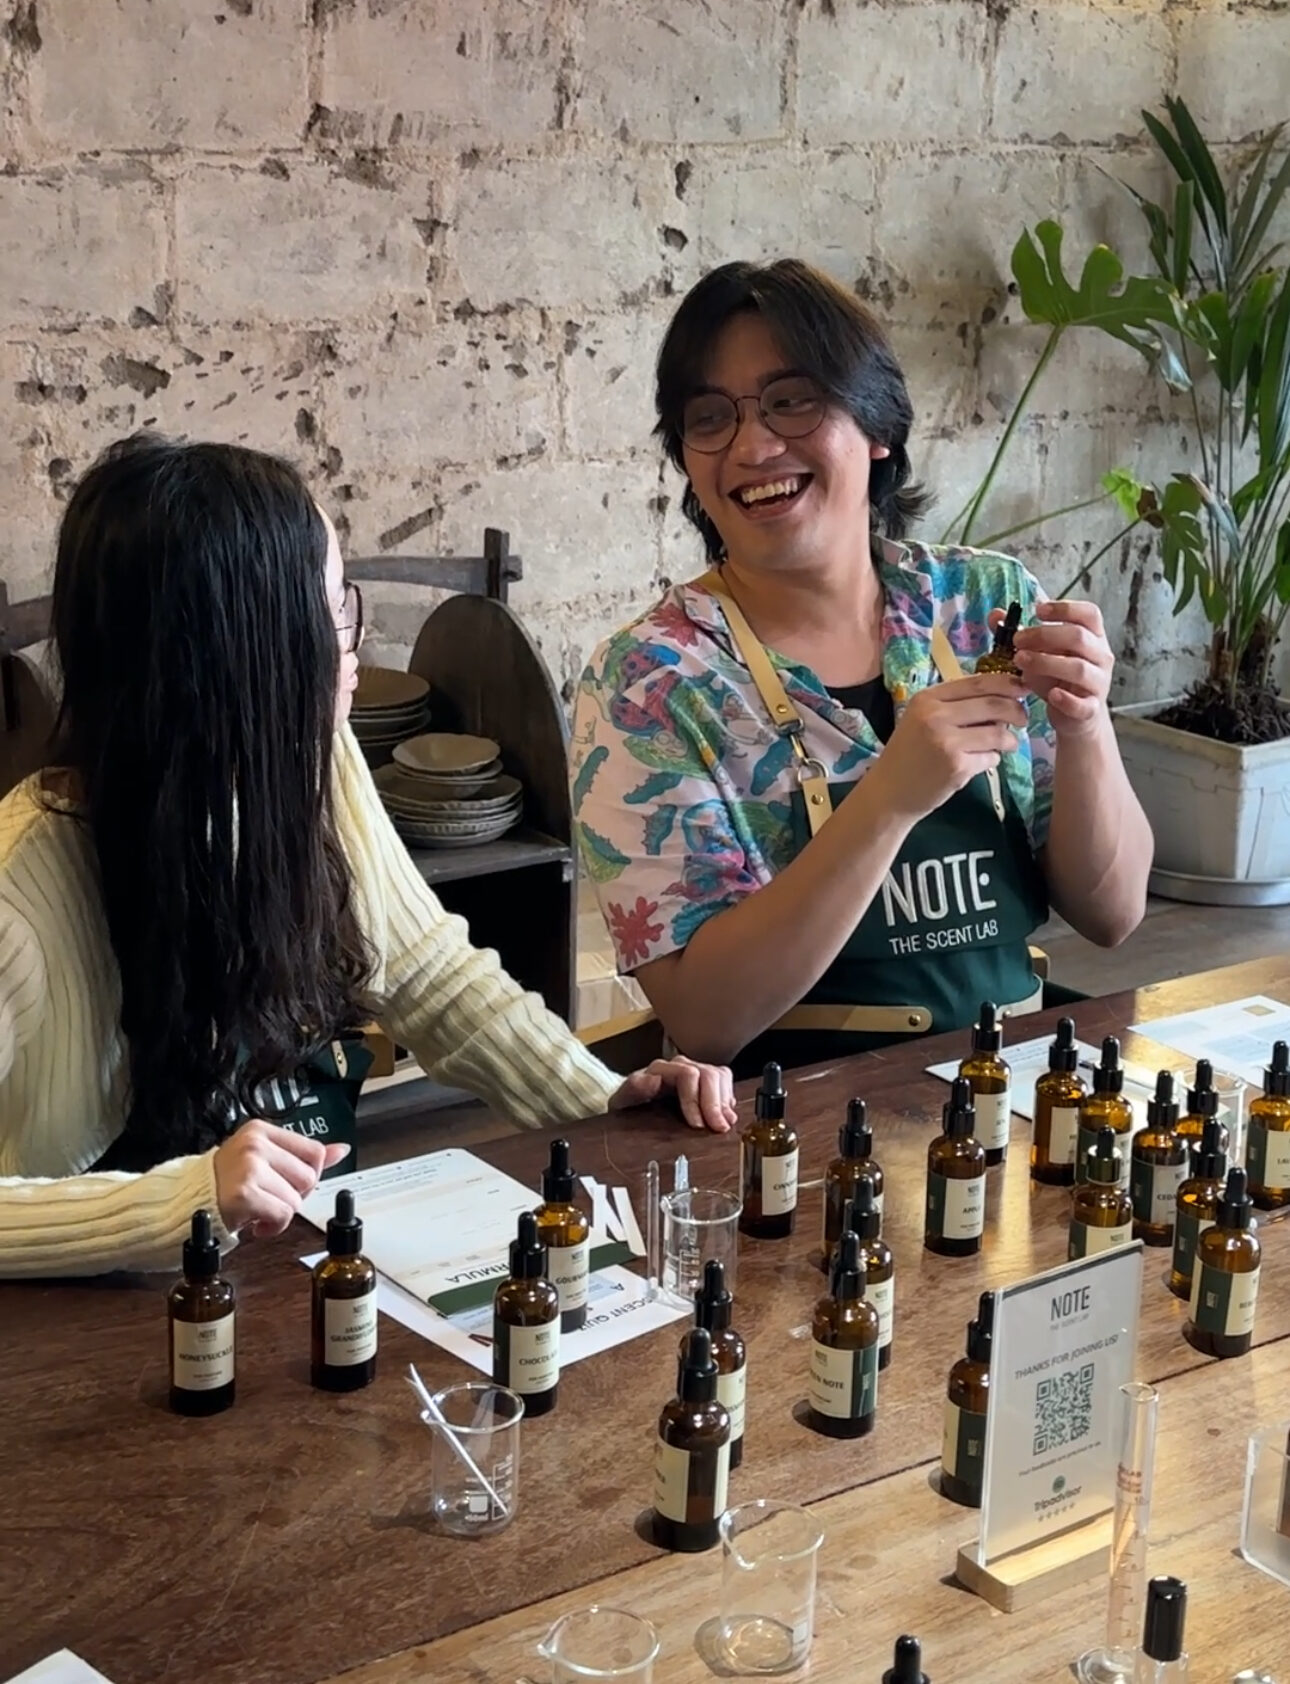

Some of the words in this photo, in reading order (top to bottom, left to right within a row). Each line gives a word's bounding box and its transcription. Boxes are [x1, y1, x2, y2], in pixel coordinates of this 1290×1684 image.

[881, 850, 997, 927] NOTE
[889, 934, 922, 956] THE
[925, 924, 973, 950] SCENT
[975, 918, 999, 941] LAB
[299, 1116, 330, 1137] LAB
[444, 1262, 511, 1283] RMULA
[1051, 1284, 1091, 1322] NOTE
[1015, 1359, 1050, 1380] THANKS
[1051, 1352, 1069, 1367] FOR
[1070, 1339, 1104, 1361] JOINING
[823, 1378, 844, 1390] NOTE
